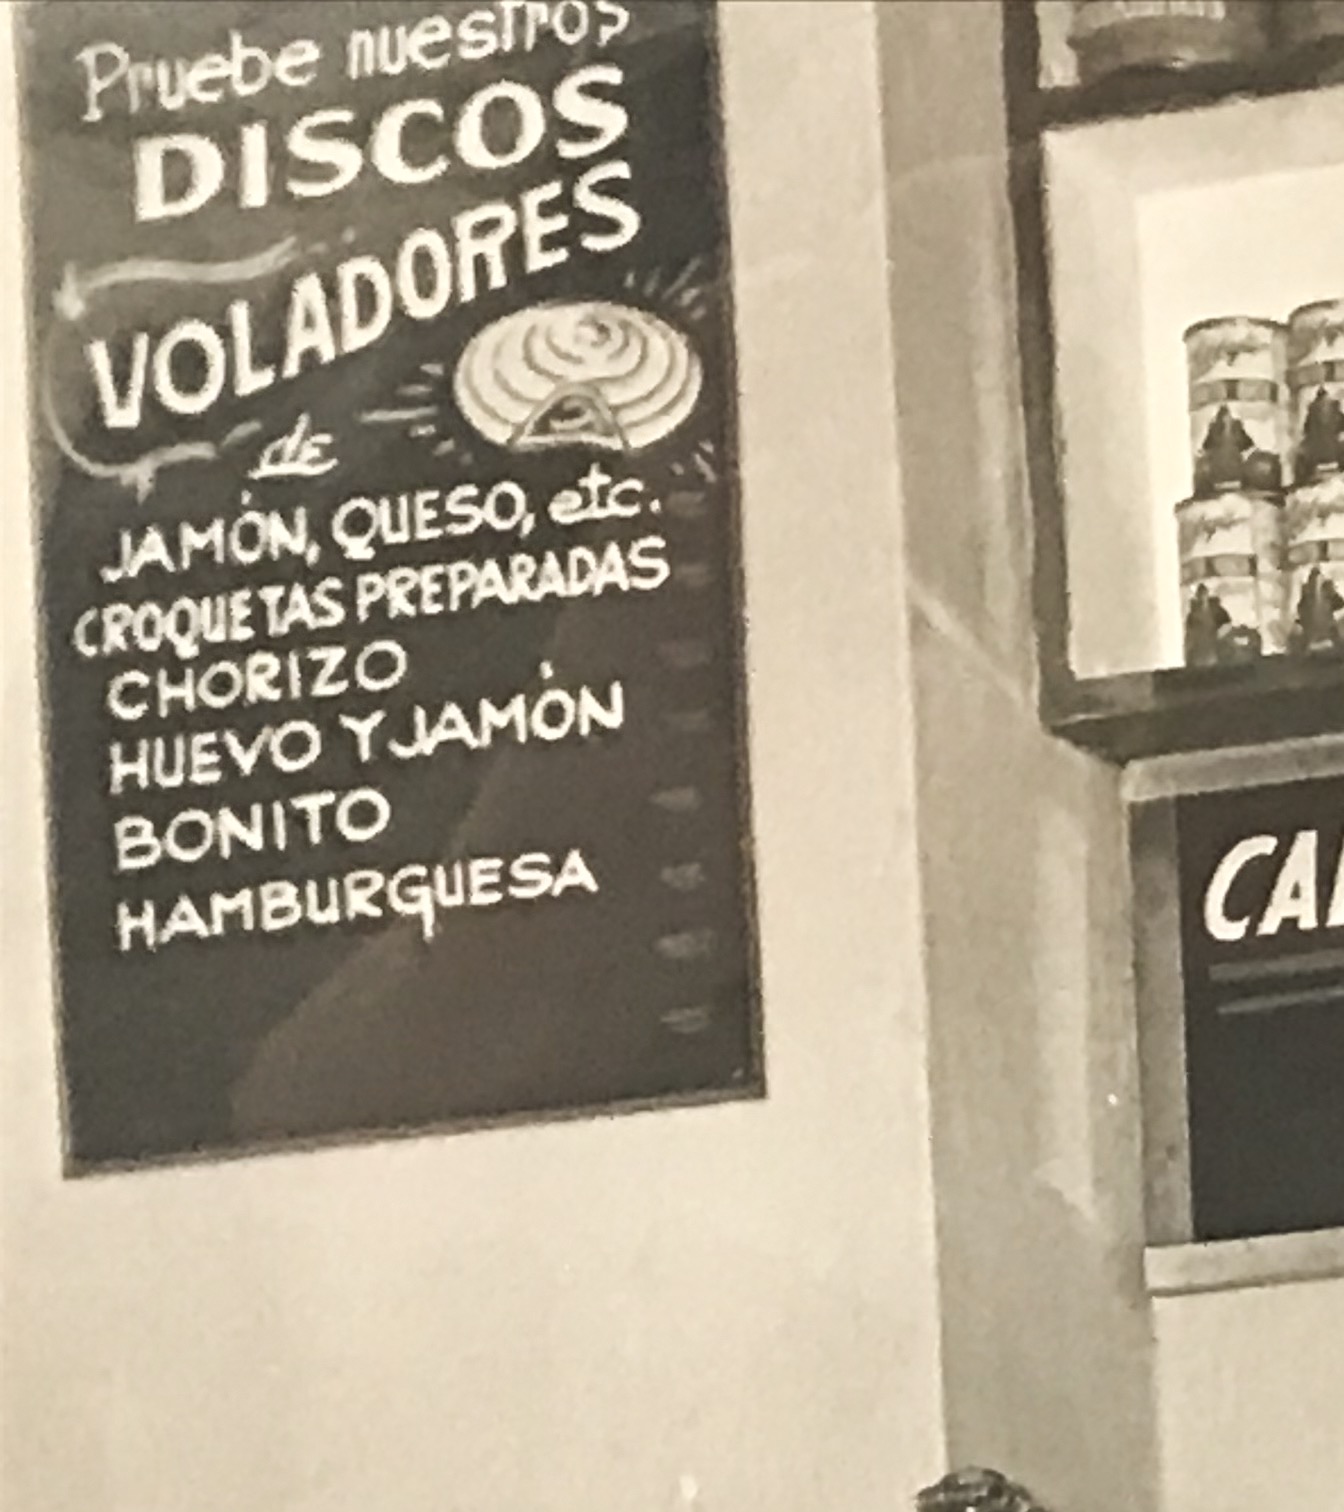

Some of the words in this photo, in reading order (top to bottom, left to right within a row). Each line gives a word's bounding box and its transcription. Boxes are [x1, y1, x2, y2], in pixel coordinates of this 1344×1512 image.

[75, 29, 323, 122] Pruebe
[347, 0, 631, 80] nuestros
[133, 65, 630, 223] DISCOS
[86, 161, 642, 430] VOLADORES
[331, 480, 536, 561] QUESO,
[548, 462, 662, 525] etc.
[70, 577, 348, 660] CROQUETAS
[355, 535, 672, 623] PREPARADAS
[106, 638, 408, 721] CHORIZO
[108, 719, 322, 795] HUEVO
[338, 708, 388, 764] Y
[113, 786, 391, 873] BONITO
